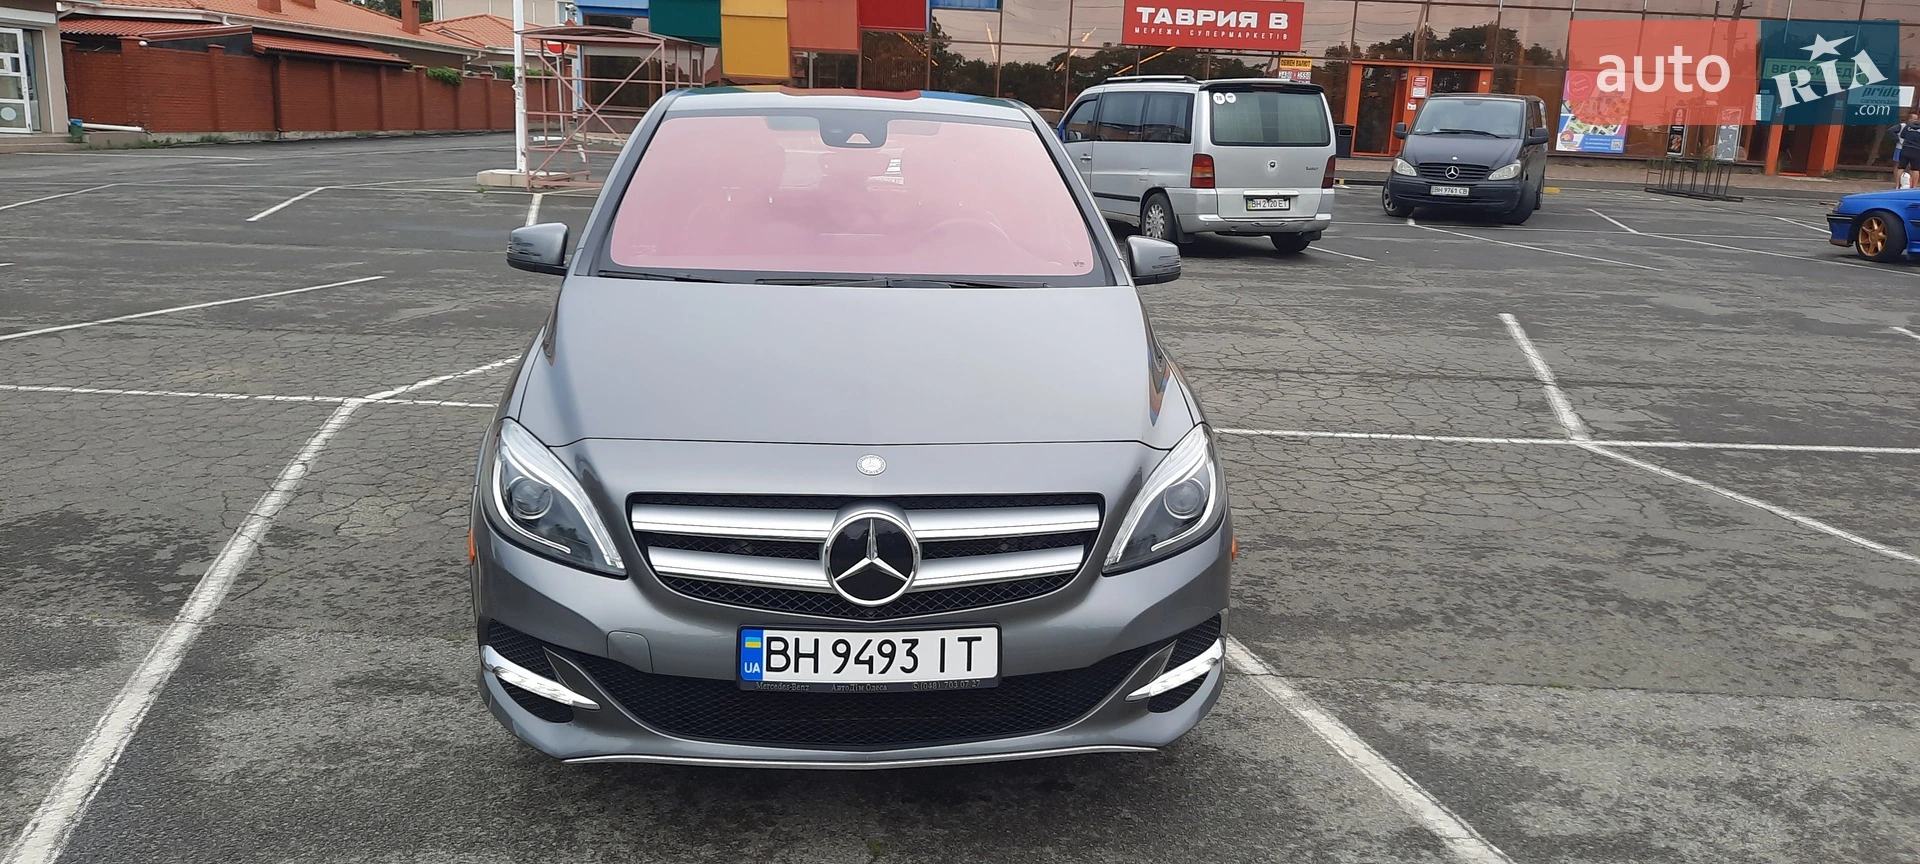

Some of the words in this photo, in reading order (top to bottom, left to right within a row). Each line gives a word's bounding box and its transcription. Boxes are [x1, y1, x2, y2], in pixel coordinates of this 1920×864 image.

[1136, 6, 1258, 29] ТАВРИЯ
[1268, 12, 1289, 30] В
[1134, 27, 1181, 36] МЕРЕЖА
[1189, 29, 1288, 41] СУПЕРМАРКЕТІВ
[1862, 87, 1901, 97] pride
[1252, 200, 1261, 208] BH
[765, 636, 819, 674] BH
[831, 638, 919, 675] 9493
[939, 636, 982, 673] IT
[744, 662, 761, 674] UA
[755, 681, 810, 691] Mercedes-Benz
[959, 680, 969, 688] 07
